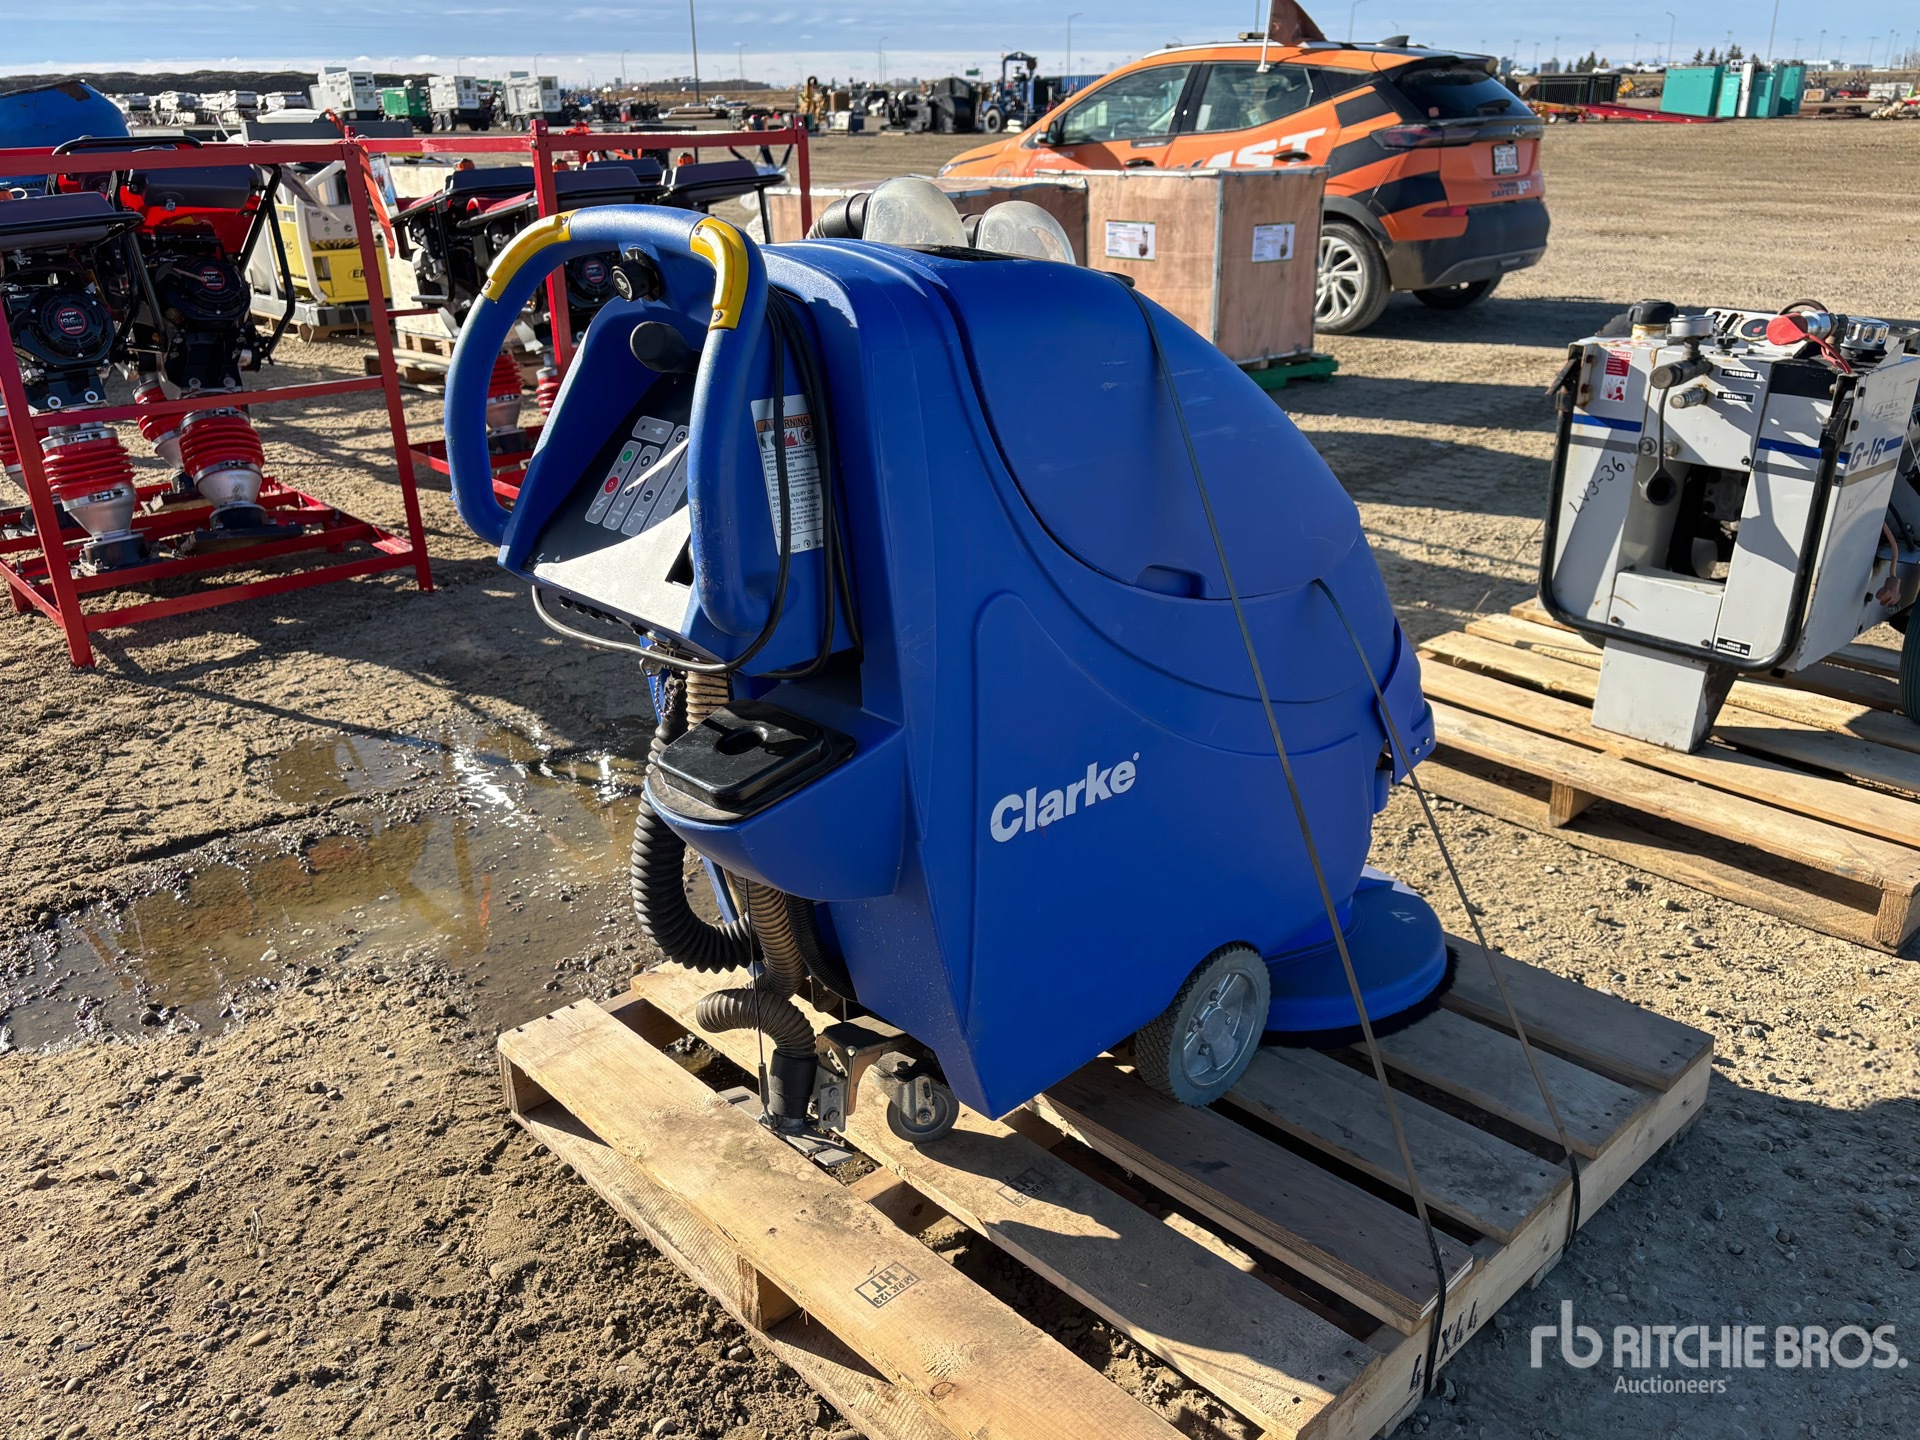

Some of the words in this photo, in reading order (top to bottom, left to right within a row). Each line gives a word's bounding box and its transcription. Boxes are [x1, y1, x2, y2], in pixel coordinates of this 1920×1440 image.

[1724, 370, 1756, 378] PRESSURE
[1849, 437, 1886, 471] G-16
[990, 760, 1136, 843] Clarke
[870, 1270, 899, 1294] HT
[872, 1290, 892, 1304] 123
